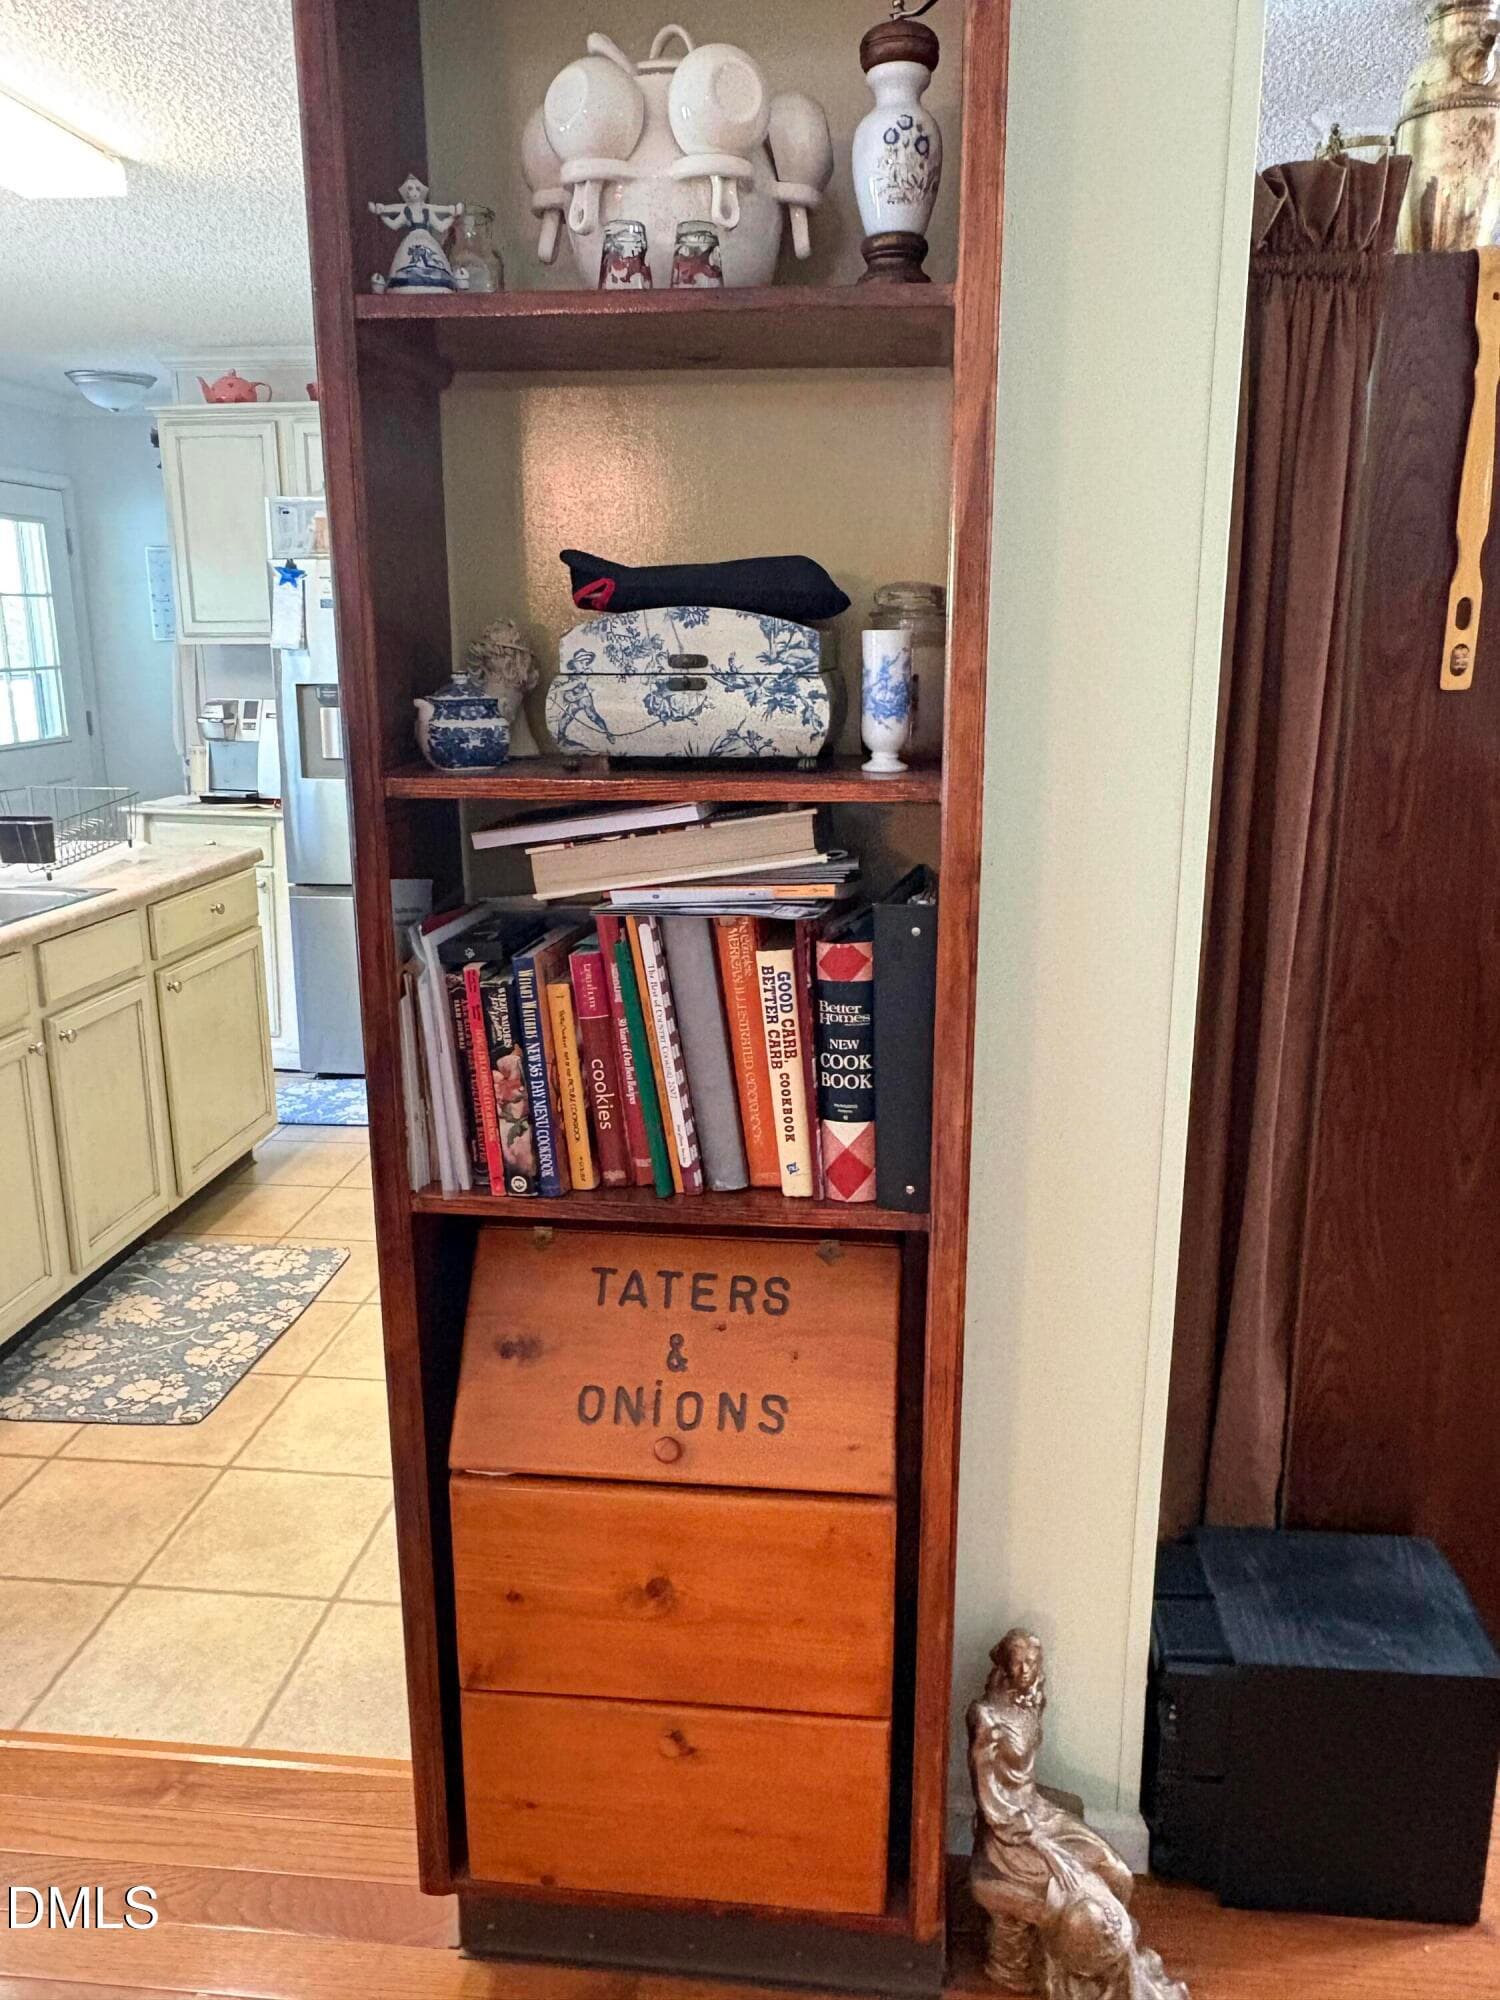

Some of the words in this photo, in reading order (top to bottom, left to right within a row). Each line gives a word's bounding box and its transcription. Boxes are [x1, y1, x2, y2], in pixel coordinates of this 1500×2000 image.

[518, 969, 535, 998] WEIGHT
[761, 965, 780, 1024] BETTER
[777, 971, 794, 1013] GOOD
[521, 1001, 538, 1039] WATCHERS
[819, 1000, 862, 1013] Better
[819, 1013, 871, 1025] Homes
[618, 1027, 629, 1044] Years
[621, 1044, 631, 1053] of
[767, 1029, 783, 1070] CARB
[780, 1018, 797, 1063] CARB,
[829, 1039, 859, 1050] NEW
[527, 1043, 541, 1061] NEW
[820, 1053, 872, 1070] COOK
[528, 1063, 542, 1077] 365
[821, 1072, 873, 1089] BOOK
[531, 1080, 545, 1099] DAY
[591, 1058, 614, 1130] cookies
[533, 1100, 549, 1128] MENU
[779, 1072, 796, 1142] COOKBOOK
[538, 1129, 554, 1177] COOKBOOK
[591, 1267, 792, 1316] TATERS
[666, 1333, 688, 1373] &
